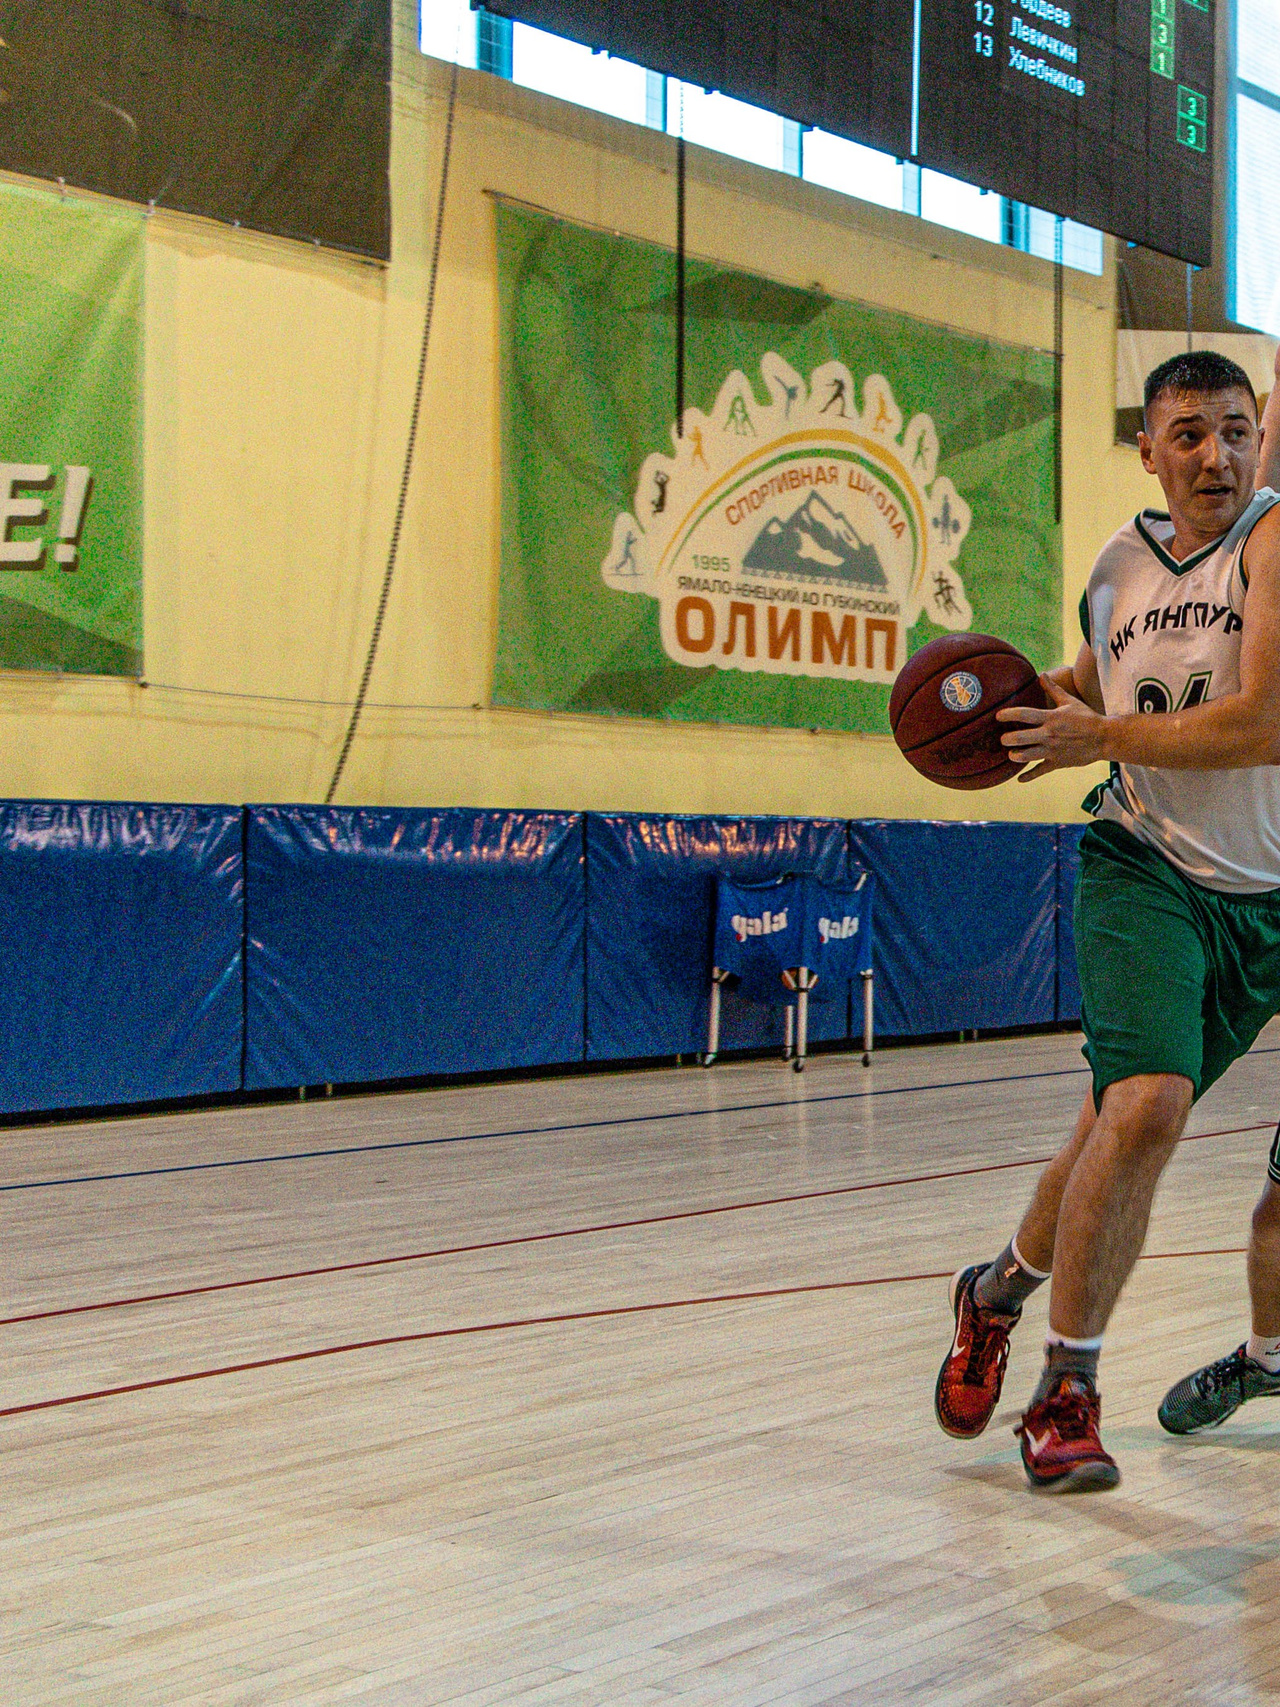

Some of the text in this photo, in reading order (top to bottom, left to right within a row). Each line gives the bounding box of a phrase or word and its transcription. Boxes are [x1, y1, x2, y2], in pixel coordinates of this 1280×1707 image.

[974, 0, 1077, 64] 12 Левичкин
[1158, 23, 1168, 44] 3
[973, 31, 1085, 96] 13 Хлебников
[1157, 52, 1165, 72] 1
[1187, 96, 1197, 117] 3
[1186, 124, 1197, 145] 3
[725, 465, 906, 539] СПОРТИВНАЯ ШКОЛА
[691, 553, 731, 573] 1995
[675, 596, 898, 672] ОЛИМП
[1109, 602, 1244, 662] НК ЯНГПУР
